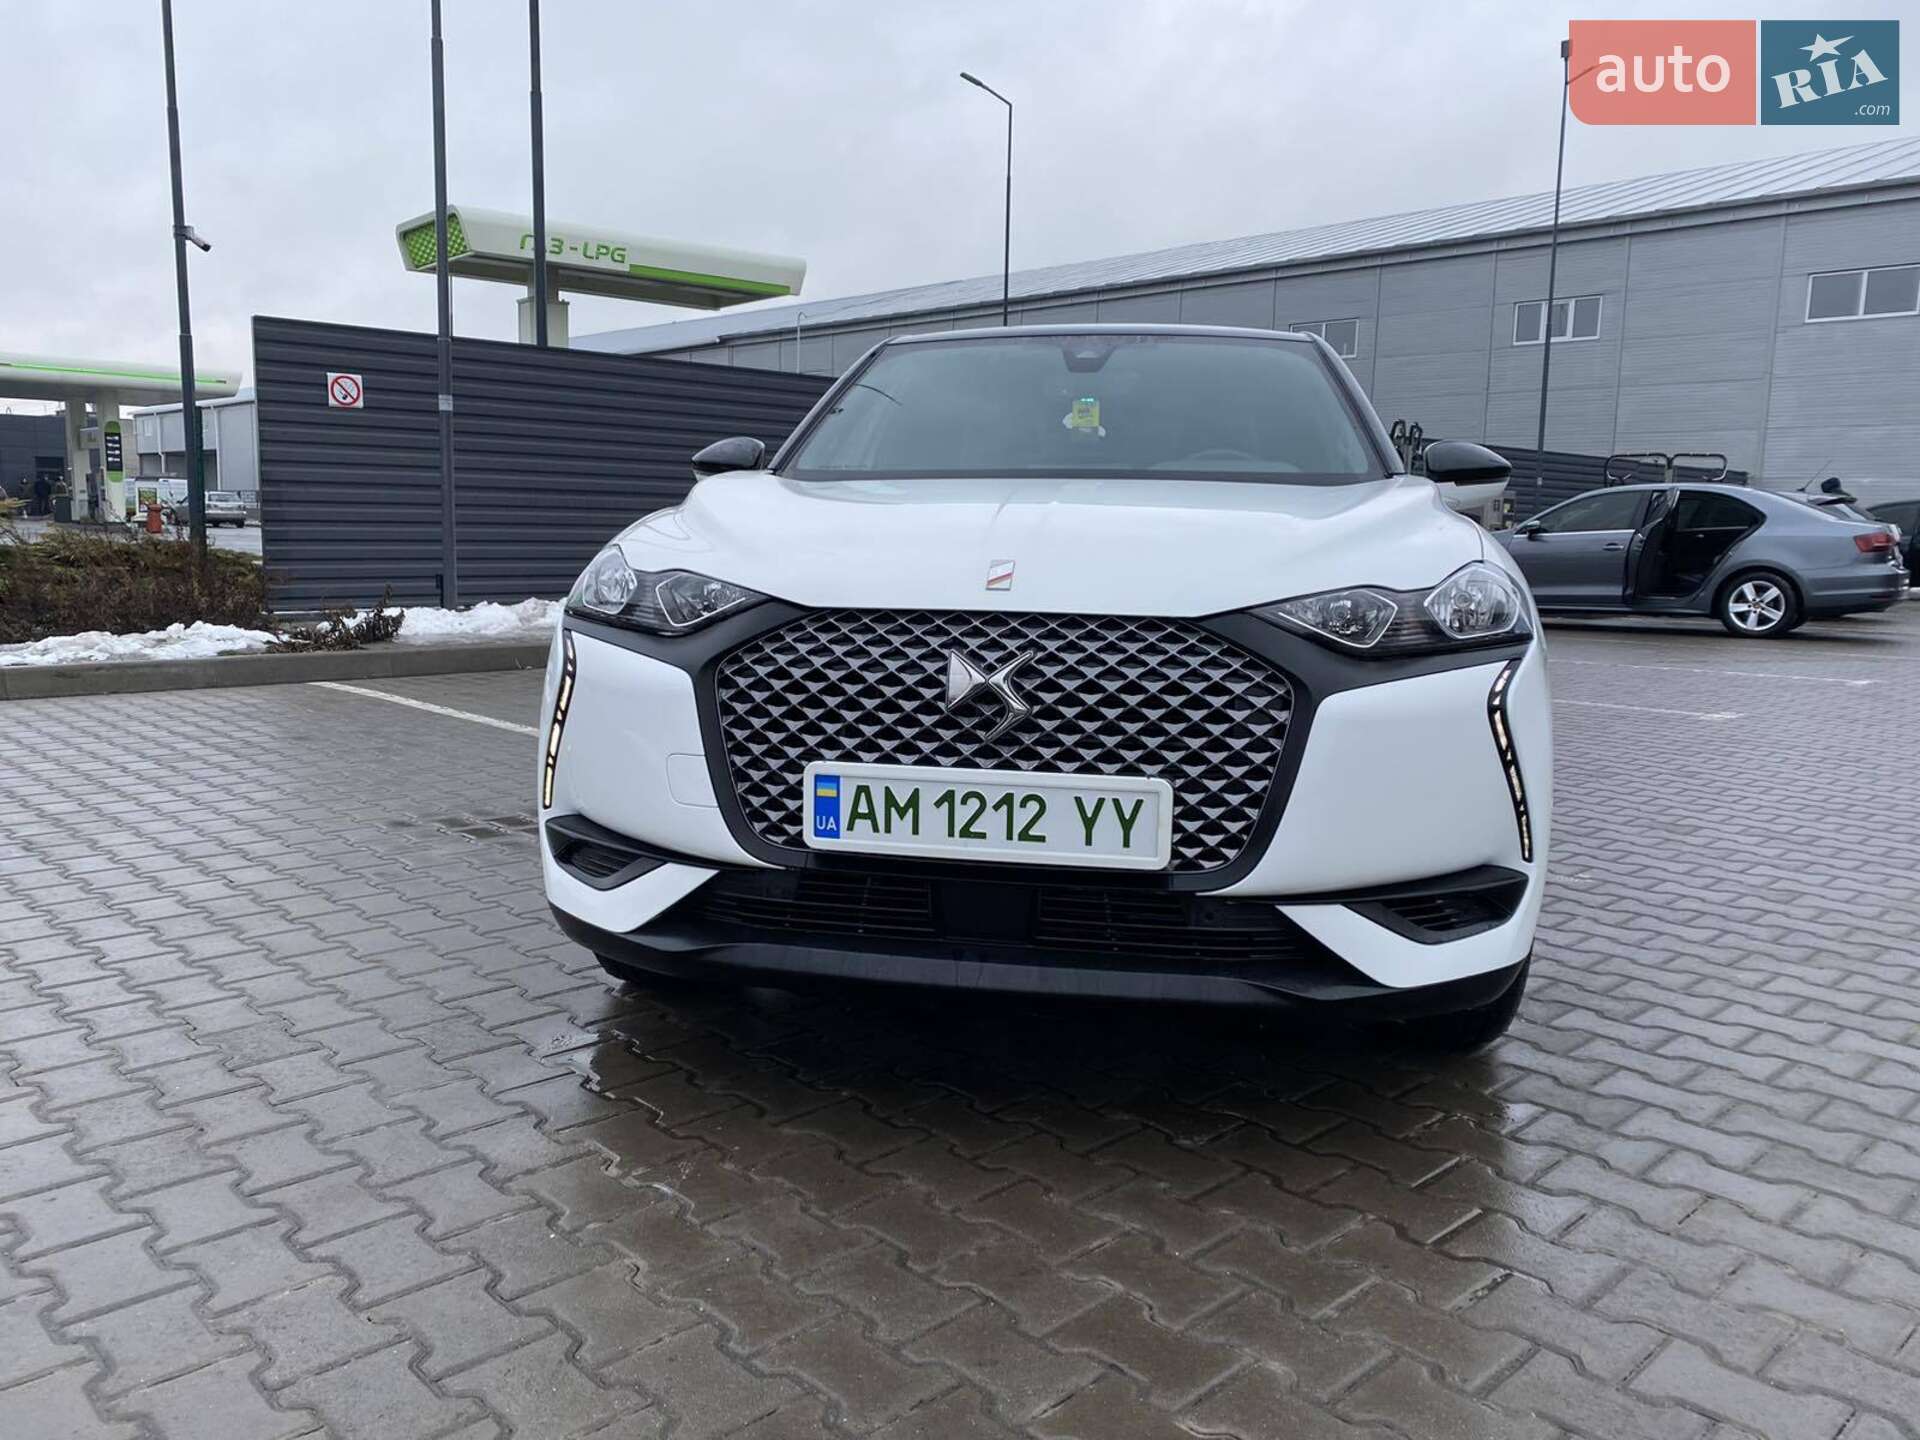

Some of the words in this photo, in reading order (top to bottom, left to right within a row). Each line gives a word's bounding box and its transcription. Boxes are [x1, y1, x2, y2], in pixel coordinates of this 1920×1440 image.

[815, 815, 838, 832] UA
[846, 784, 920, 836] AM
[933, 788, 1047, 843] 1212
[1073, 795, 1145, 848] YY
